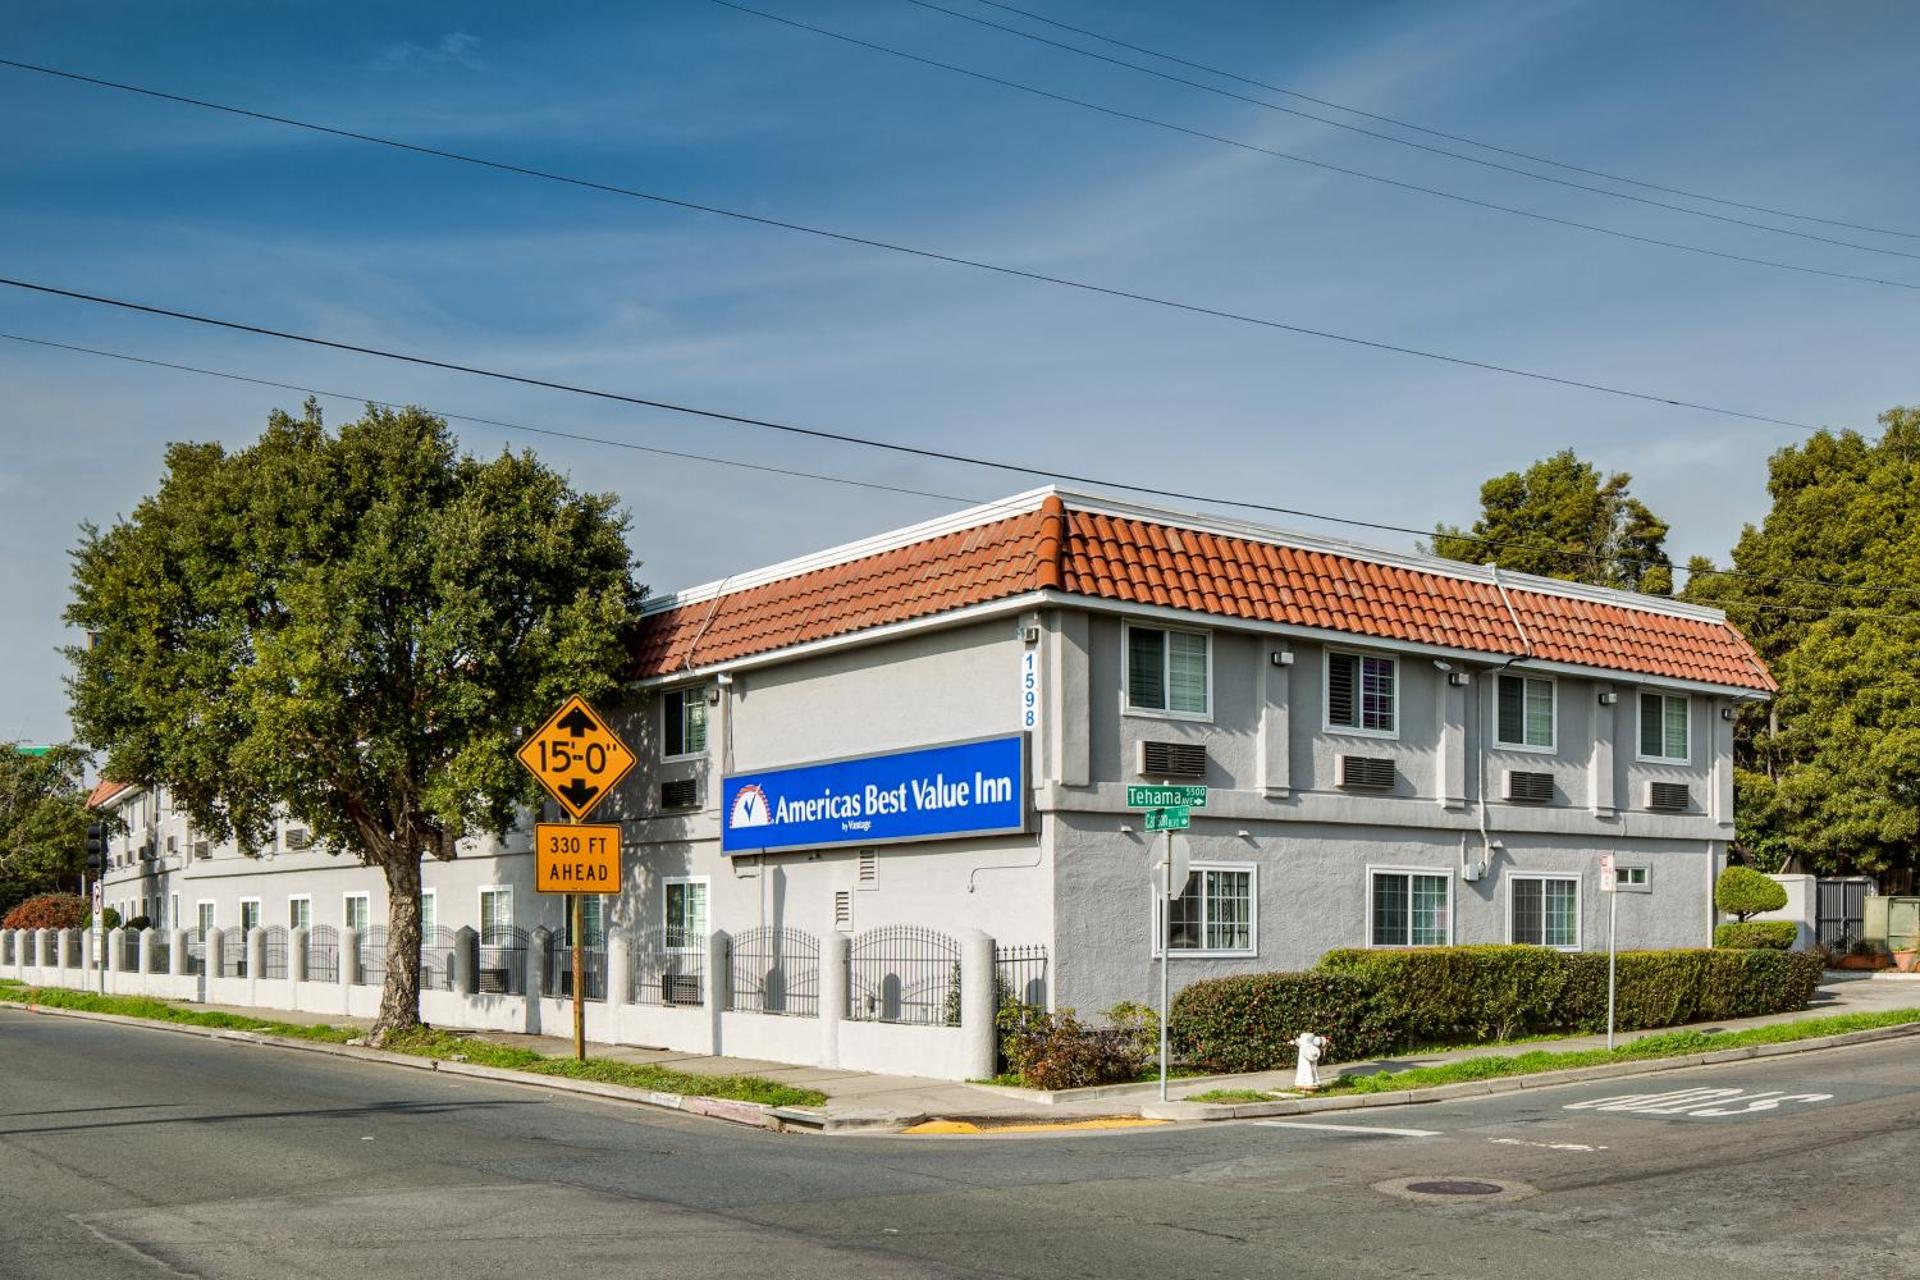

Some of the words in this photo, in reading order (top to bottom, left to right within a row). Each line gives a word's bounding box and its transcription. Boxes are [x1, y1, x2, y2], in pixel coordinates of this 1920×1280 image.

[1025, 653, 1035, 727] 1598
[775, 788, 861, 825] Americas
[865, 784, 907, 815] Best
[911, 773, 969, 811] Value
[975, 771, 1012, 805] Inn
[1129, 788, 1181, 805] Tehama
[841, 821, 848, 833] by
[848, 819, 872, 832] Vantage
[550, 837, 580, 854] 330
[589, 837, 607, 854] FT
[550, 864, 608, 881] AHEAD
